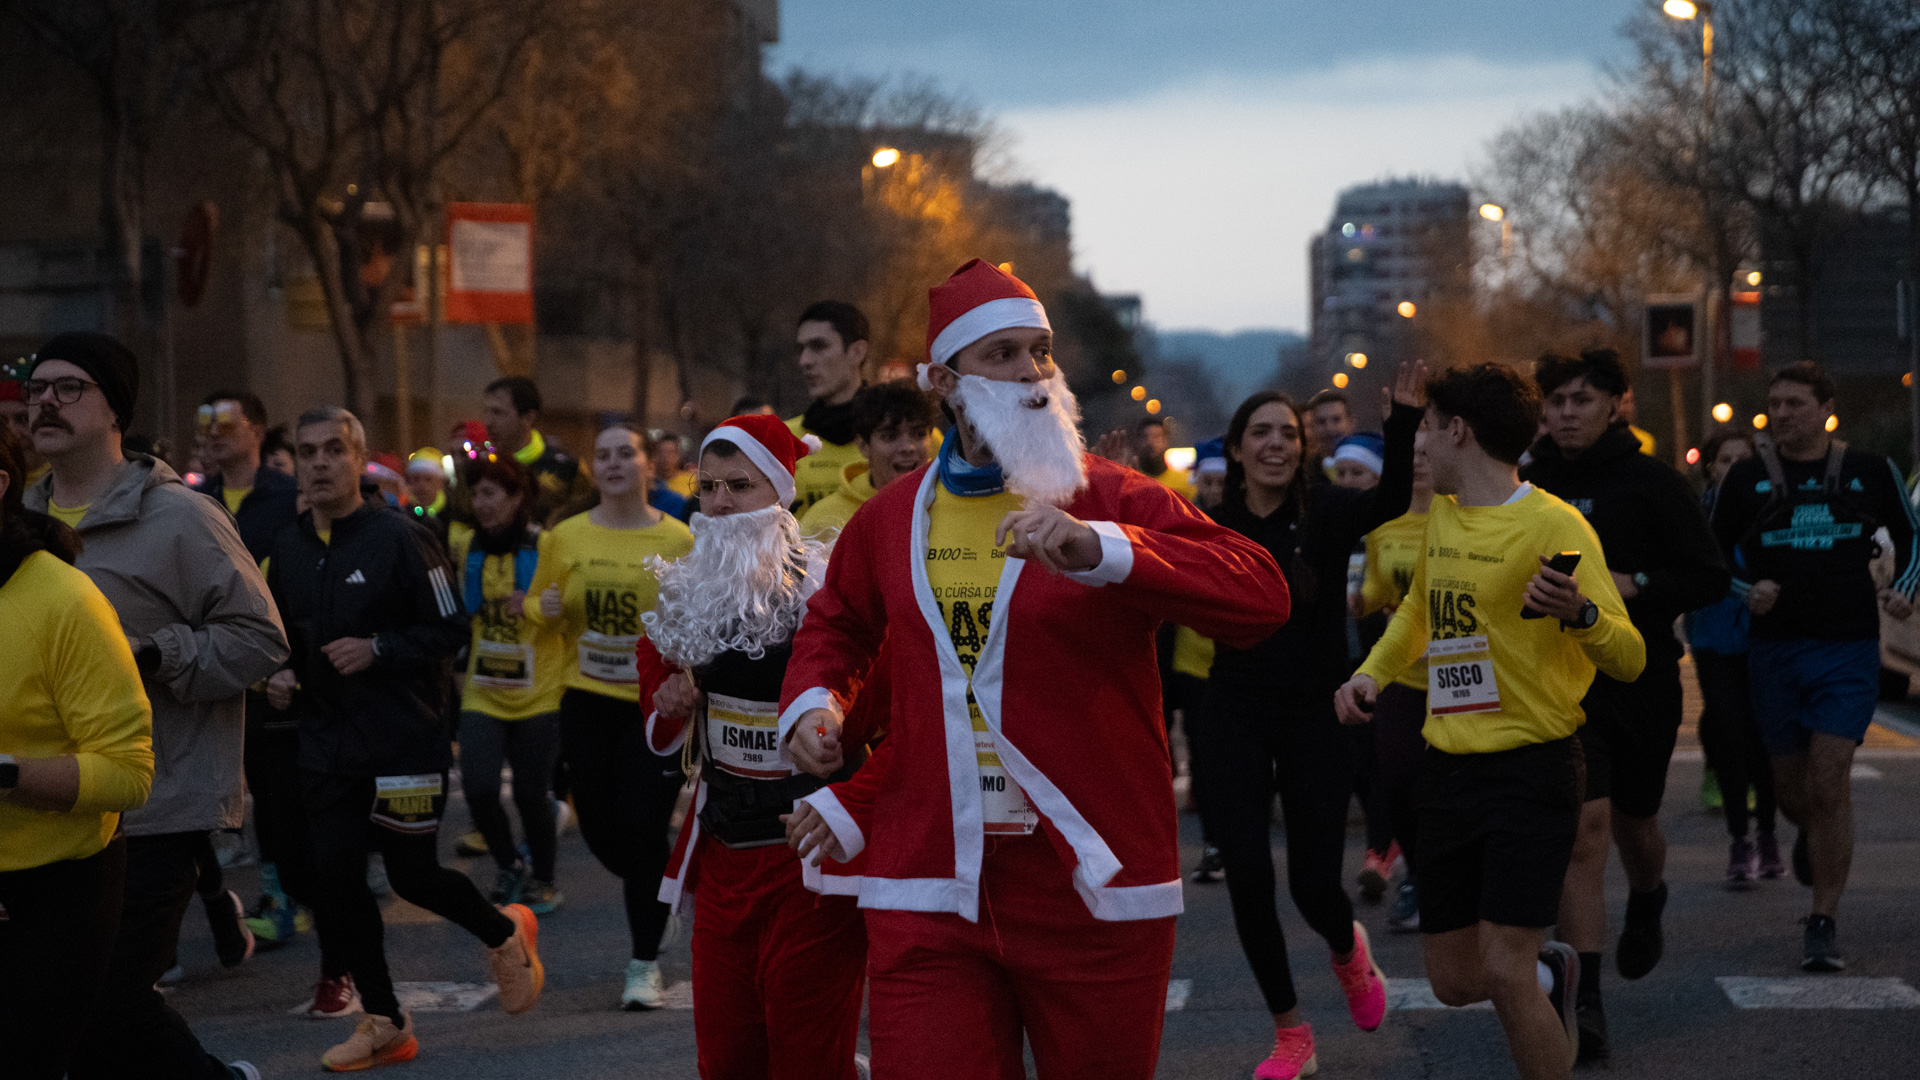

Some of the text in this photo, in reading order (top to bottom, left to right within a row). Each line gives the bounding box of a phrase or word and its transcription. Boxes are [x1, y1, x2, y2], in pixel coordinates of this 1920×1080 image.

[927, 548, 961, 560] B100
[991, 549, 1006, 559] Bar
[585, 589, 637, 618] NAS
[945, 587, 981, 598] CURSA
[984, 587, 997, 598] DE
[1429, 589, 1478, 632] NAS
[937, 601, 994, 652] AS
[1437, 663, 1484, 689] SISCO
[722, 725, 778, 751] ISMAE
[743, 752, 763, 763] 2989
